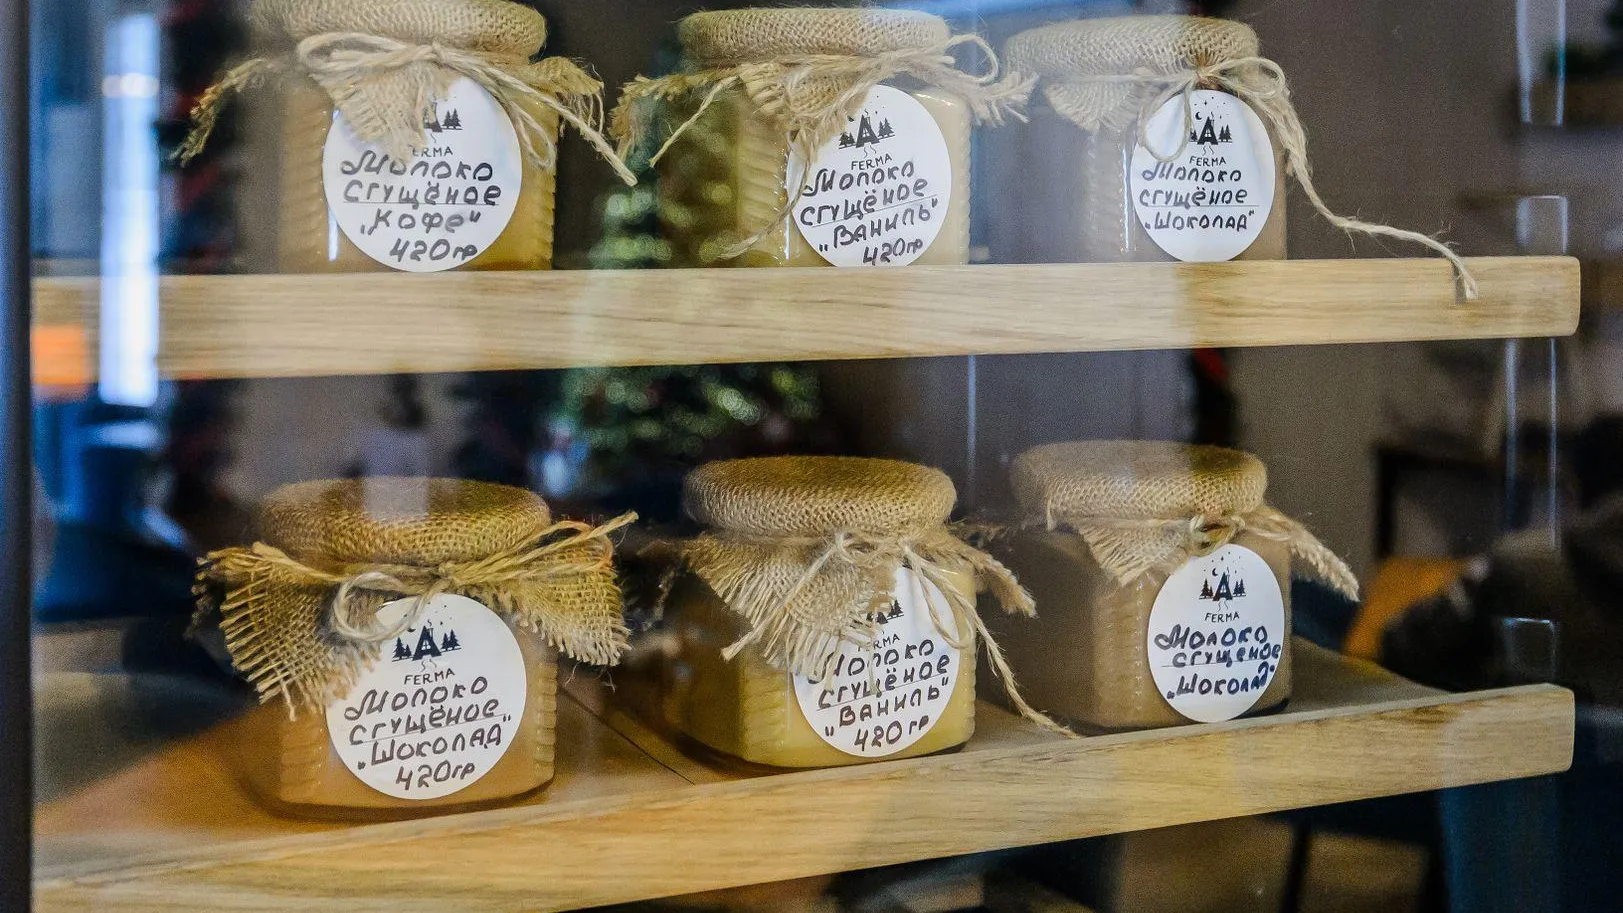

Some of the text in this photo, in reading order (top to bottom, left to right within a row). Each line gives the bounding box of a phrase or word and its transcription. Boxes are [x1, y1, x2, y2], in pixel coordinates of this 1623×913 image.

[407, 144, 454, 158] ERMA
[851, 153, 893, 171] FERMA
[1189, 155, 1227, 167] FERMA
[1204, 611, 1240, 623] FERMA
[857, 633, 900, 652] RMA
[404, 668, 455, 686] FERMA
[396, 760, 475, 790] 420гр
